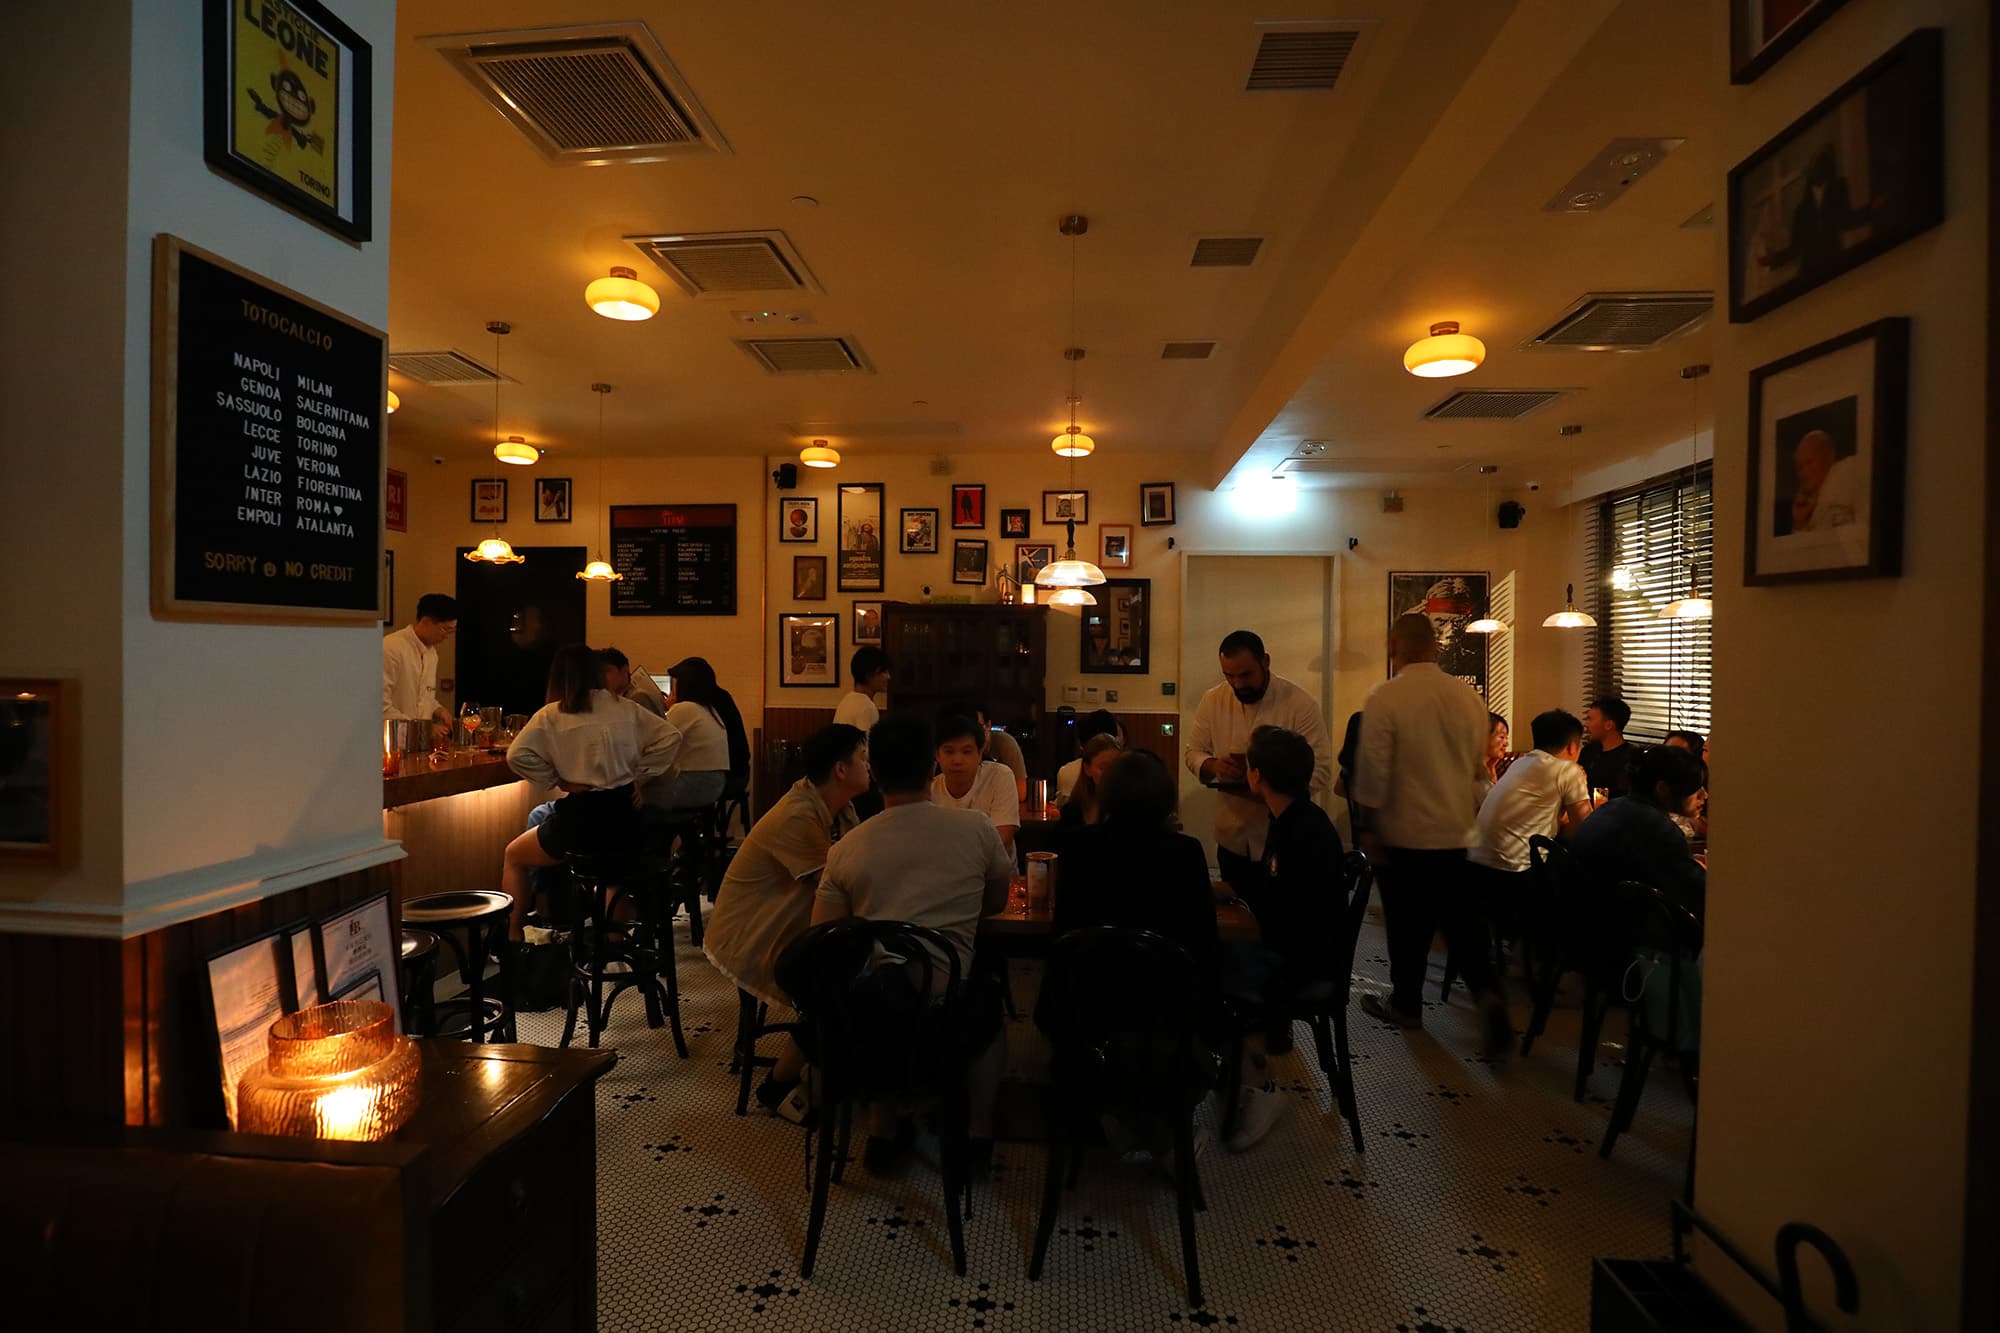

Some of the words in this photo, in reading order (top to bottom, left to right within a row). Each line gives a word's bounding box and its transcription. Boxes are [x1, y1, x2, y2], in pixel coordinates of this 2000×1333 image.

[245, 0, 329, 80] LEONE
[299, 170, 330, 198] TORINO
[241, 298, 333, 351] TOTOCALCIO
[233, 351, 280, 381] NAPOLI
[297, 374, 333, 399] MILAN
[216, 391, 283, 422] SASSUOLO
[296, 415, 346, 441] BOLOGNA
[240, 377, 282, 402] GENOA
[296, 395, 370, 430] SALERNITANA
[243, 419, 280, 443] LECCE
[296, 435, 338, 459] TORINO
[251, 445, 282, 464] JUVE
[296, 455, 342, 478] VERONA
[243, 463, 282, 484] LAZIO
[297, 476, 363, 501] FIORENTINA
[244, 485, 282, 505] INTER
[296, 496, 331, 515] ROMA
[237, 505, 281, 527] EMPOLI
[296, 515, 355, 540] ATALANTA
[205, 551, 257, 575] SORRY
[284, 560, 304, 577] NO
[310, 562, 354, 583] CREDIT
